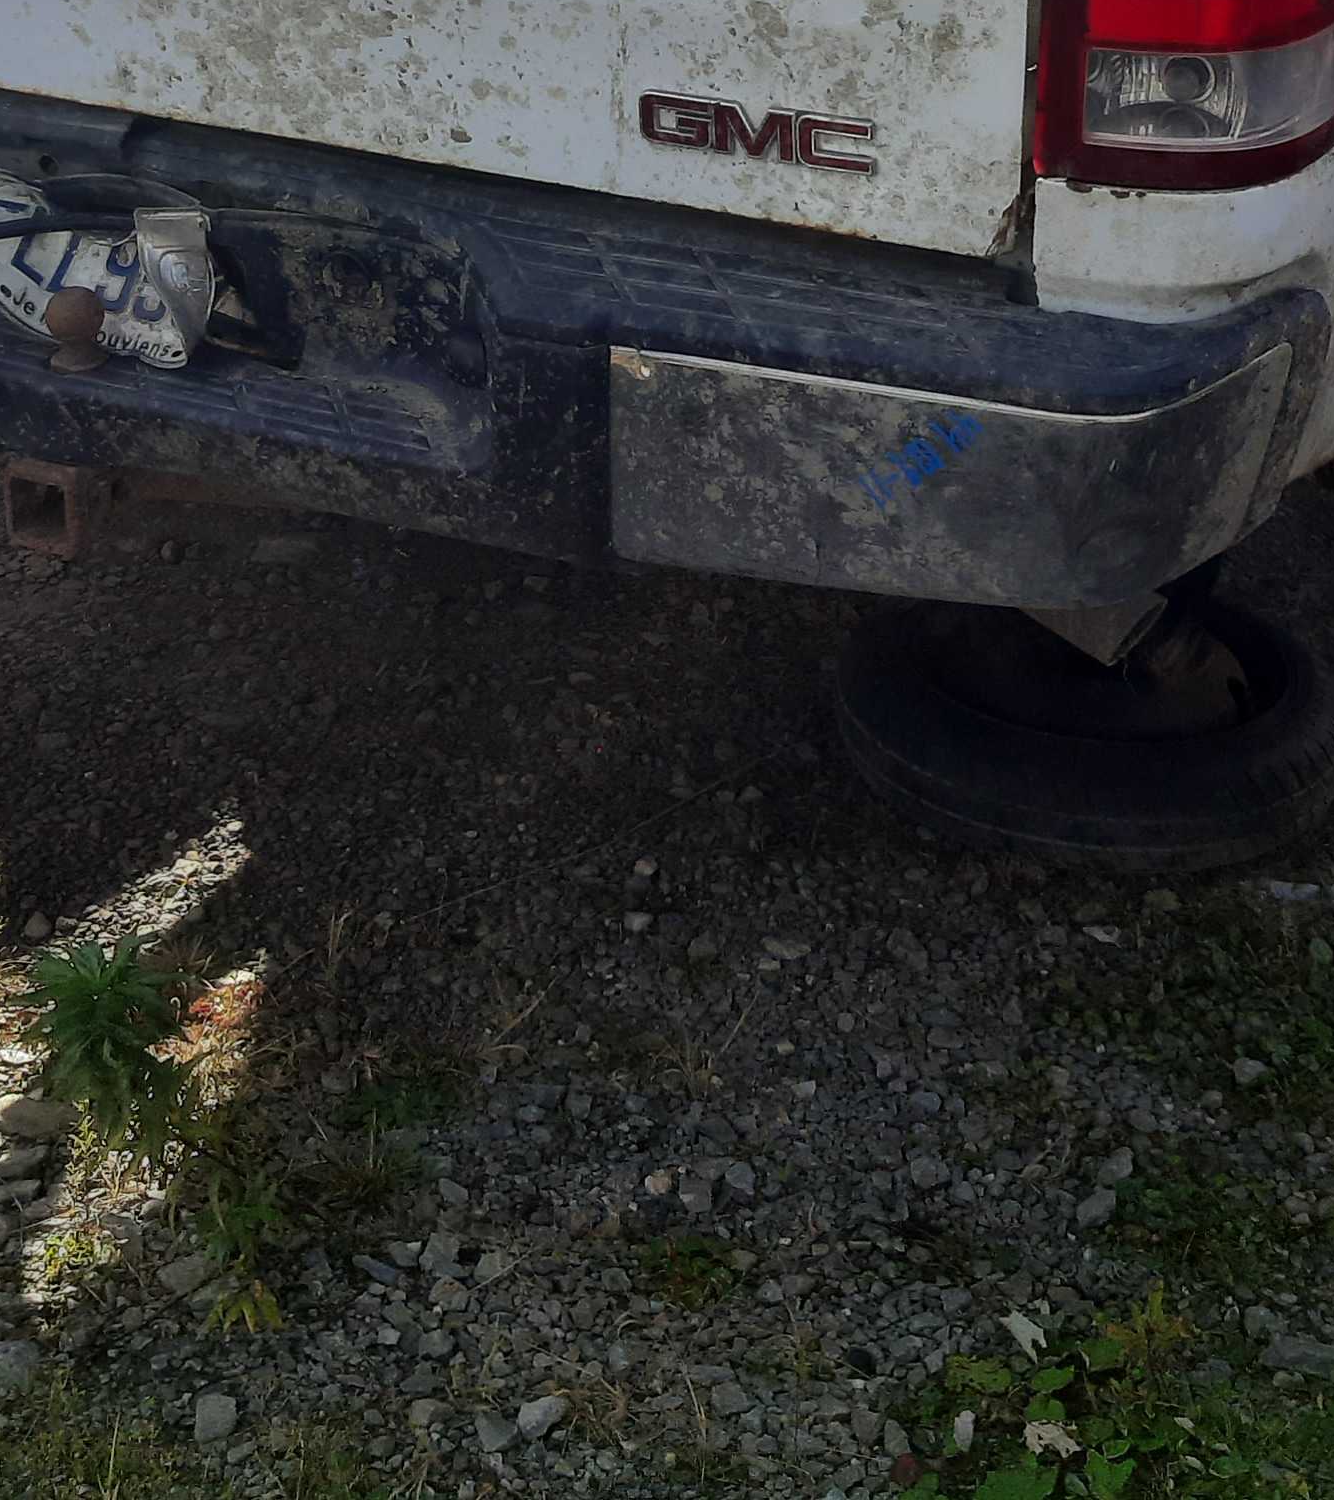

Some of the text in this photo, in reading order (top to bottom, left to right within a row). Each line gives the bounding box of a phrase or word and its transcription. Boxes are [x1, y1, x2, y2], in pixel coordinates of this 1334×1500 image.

[637, 88, 877, 177] GMC
[13, 286, 36, 316] Je
[94, 330, 171, 359] ouviens
